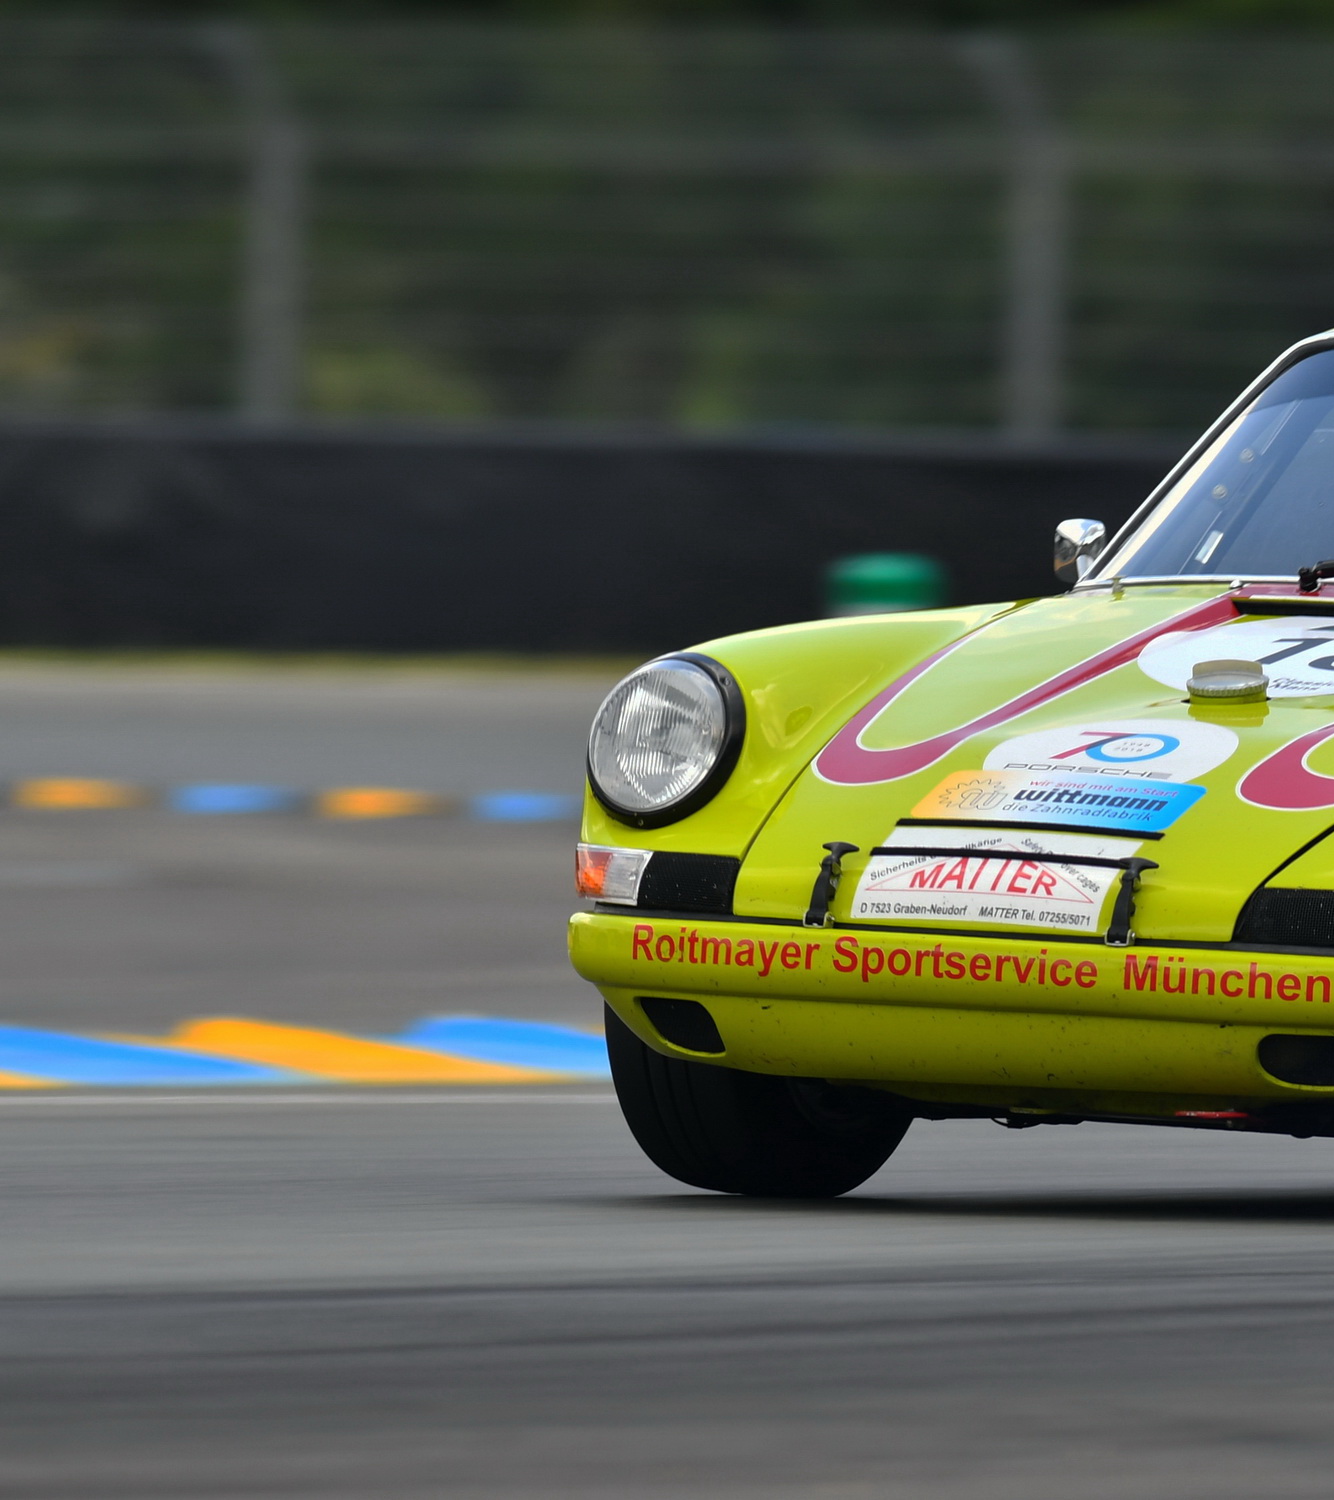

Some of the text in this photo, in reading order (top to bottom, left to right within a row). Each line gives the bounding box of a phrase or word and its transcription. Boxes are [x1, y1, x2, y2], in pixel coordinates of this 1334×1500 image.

[1049, 731, 1180, 762] 70
[1003, 763, 1173, 779] PORSCHE
[1013, 788, 1168, 812] wittmann
[1055, 781, 1086, 789] sind
[1088, 783, 1113, 791] mit
[1141, 787, 1178, 798] Start
[1002, 802, 1153, 822] die Zahnradfabrik
[869, 855, 927, 881] Sicherheits
[908, 856, 1057, 896] MATTER
[860, 903, 967, 916] D 7523 Graben-Neudorf
[978, 907, 1091, 927] MATTER Tel. 07255/5071
[832, 936, 1098, 989] Sportservice
[1122, 954, 1333, 1003] München
